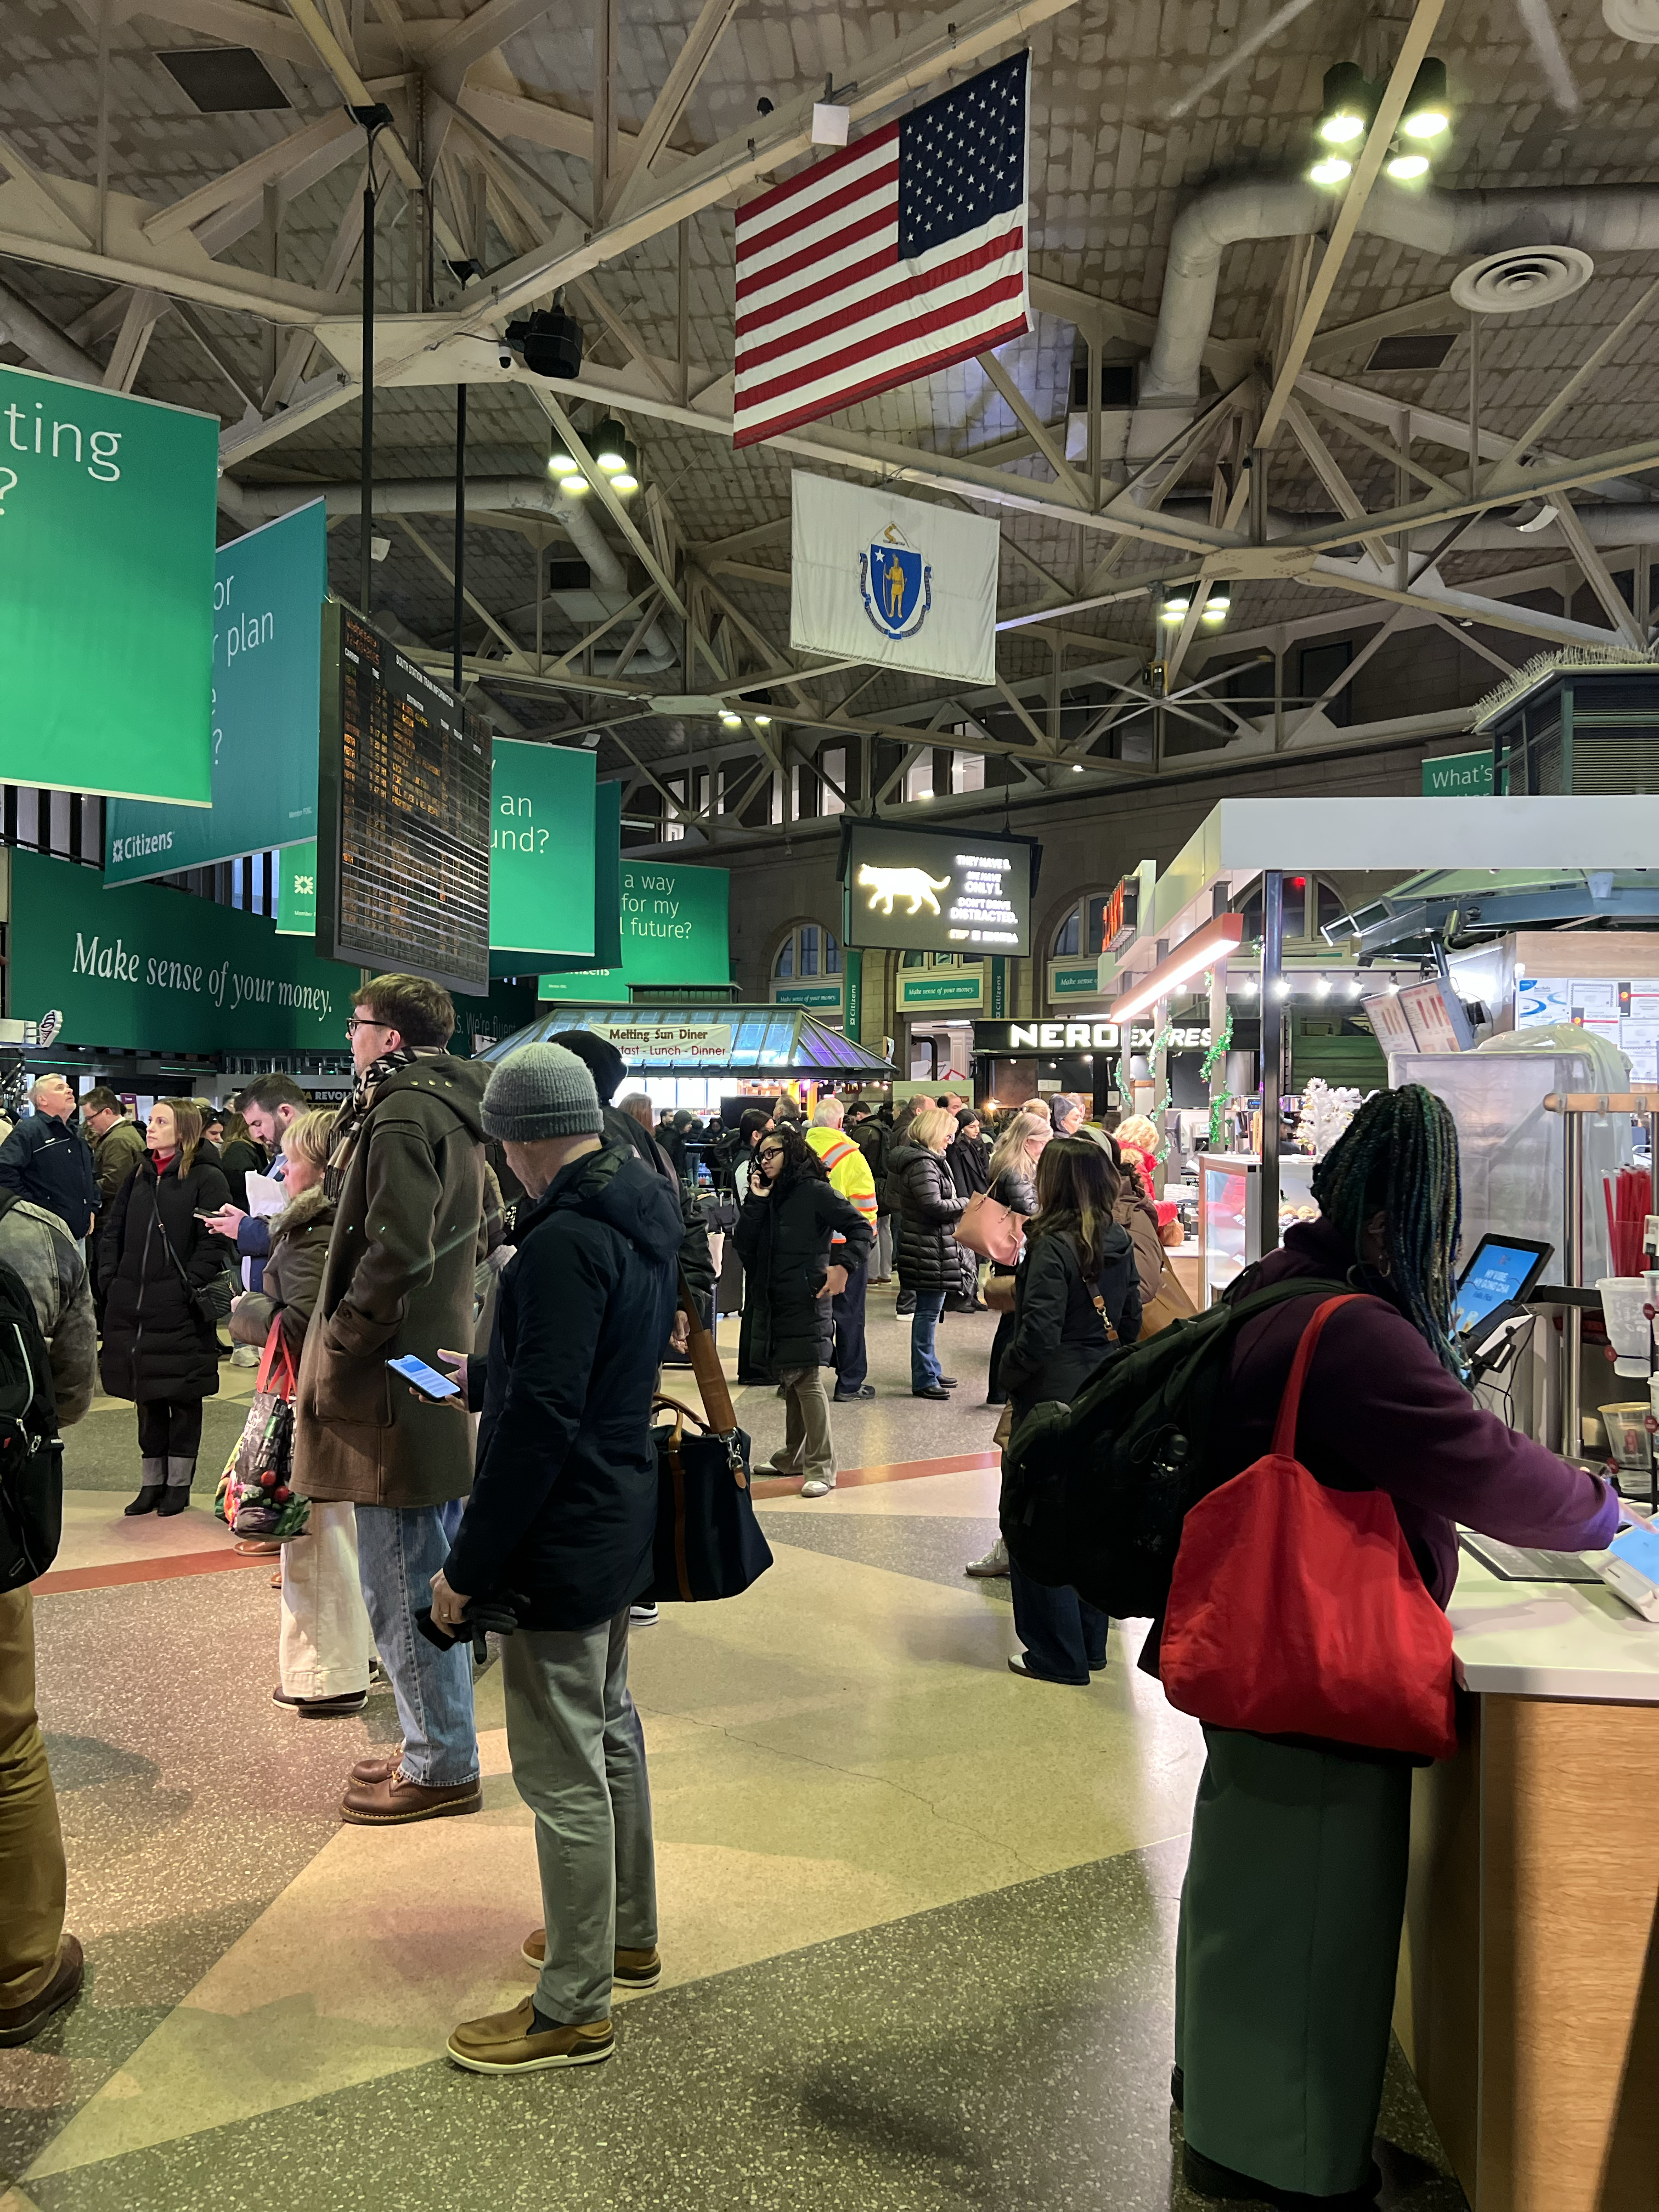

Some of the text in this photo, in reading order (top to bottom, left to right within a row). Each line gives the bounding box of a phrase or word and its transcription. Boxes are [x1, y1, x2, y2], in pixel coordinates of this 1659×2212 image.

[228, 612, 273, 668] plan
[1432, 764, 1493, 788] What's
[500, 795, 532, 817] an
[125, 831, 172, 859] Citizens
[624, 874, 675, 895] a way
[964, 881, 994, 894] ONLY
[622, 893, 679, 919] for my
[950, 907, 1018, 923] DISTRACTED.
[631, 917, 692, 939] future?
[72, 933, 332, 1022] Make sense of your money.
[804, 995, 810, 1003] of
[936, 987, 943, 995] of
[466, 1012, 490, 1035] We're
[493, 1015, 516, 1040] fluent
[609, 1029, 708, 1042] Melting Sun Diner
[1010, 1023, 1119, 1048] NERO
[650, 1045, 681, 1056] Lunch
[692, 1045, 726, 1056] Dinner
